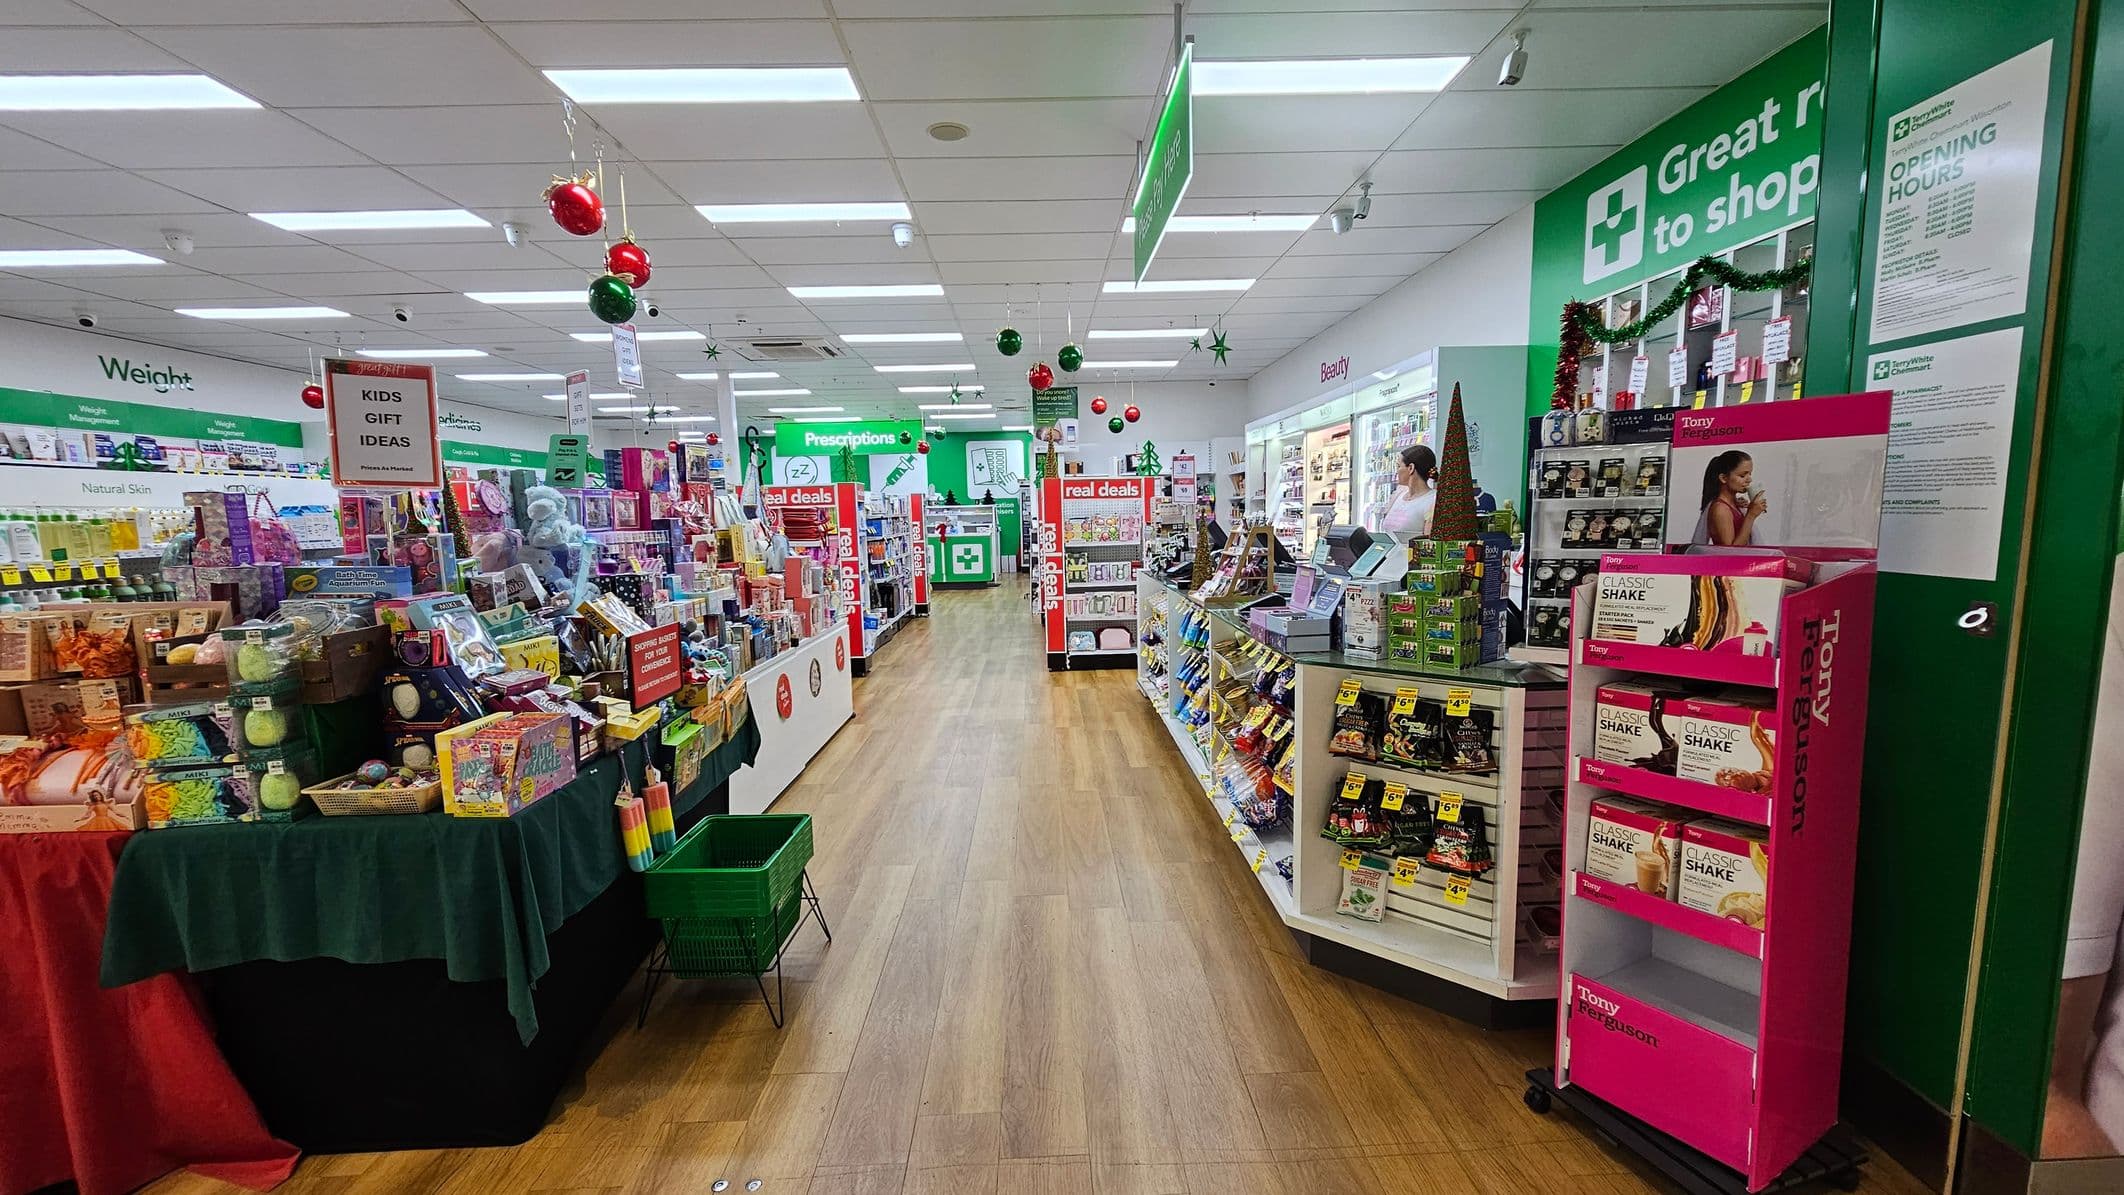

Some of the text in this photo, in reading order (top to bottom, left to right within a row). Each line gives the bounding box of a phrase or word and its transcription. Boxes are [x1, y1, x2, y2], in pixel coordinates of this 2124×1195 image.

[1911, 100, 1955, 123] TerryWhite
[1657, 80, 1825, 194] Great r
[1164, 129, 1181, 185] Here
[1890, 123, 1998, 181] OPENING
[1888, 158, 1965, 204] HOURS
[1653, 154, 1821, 254] to shop
[1320, 355, 1350, 383] Beauty
[1890, 363, 1932, 376] Chemmart
[1891, 355, 1935, 368] TerryWhite
[98, 355, 194, 393] Weight
[362, 389, 402, 403] KIDS
[78, 405, 107, 416] Weight
[365, 412, 403, 425] GIFT
[69, 413, 120, 426] Management
[439, 412, 482, 432] edicines
[1681, 417, 1715, 429] Tony
[360, 434, 411, 448] IDEAS
[805, 431, 896, 448] Prescriptions
[1681, 425, 1744, 441] Ferguson
[82, 482, 152, 495] Natural Skin
[766, 488, 832, 506] eal deals
[1065, 481, 1139, 497] real deals
[912, 521, 926, 543] real
[1045, 522, 1063, 558] real
[840, 527, 859, 561] real
[912, 546, 926, 577] deals
[1605, 556, 1624, 565] Tony
[335, 571, 377, 579] Bath Time
[1602, 575, 1656, 590] CLASSIC
[328, 580, 368, 588] Aquarium
[843, 567, 862, 615] deals
[1045, 561, 1064, 610] deals
[1601, 588, 1647, 602] SHAKE
[438, 600, 458, 610] MIKI
[523, 641, 541, 651] MIKI
[634, 638, 658, 653] SHOPPING
[1588, 644, 1609, 655] Tony
[1813, 609, 1841, 727] Tony
[1601, 691, 1615, 700] Tony
[167, 709, 191, 719] MIKI
[1687, 703, 1701, 713] Tony
[1599, 707, 1649, 727] CLASSIC
[1792, 613, 1822, 836] Ferguson
[1599, 719, 1642, 737] SHAKE
[1684, 721, 1741, 742] CLASSIC
[1684, 734, 1733, 753] SHAKE
[184, 770, 210, 779] MIKI
[1586, 763, 1606, 775] Tony
[1595, 804, 1609, 814] Tony
[1593, 821, 1641, 845] CLASSIC
[1687, 829, 1703, 839] Tony
[1592, 832, 1634, 854] SHAKE
[1686, 846, 1743, 872] CLASSIC
[1685, 859, 1735, 883] SHAKE
[1581, 879, 1602, 893] Tony
[1577, 984, 1621, 1016] Tony
[1577, 1000, 1660, 1049] Ferguson
